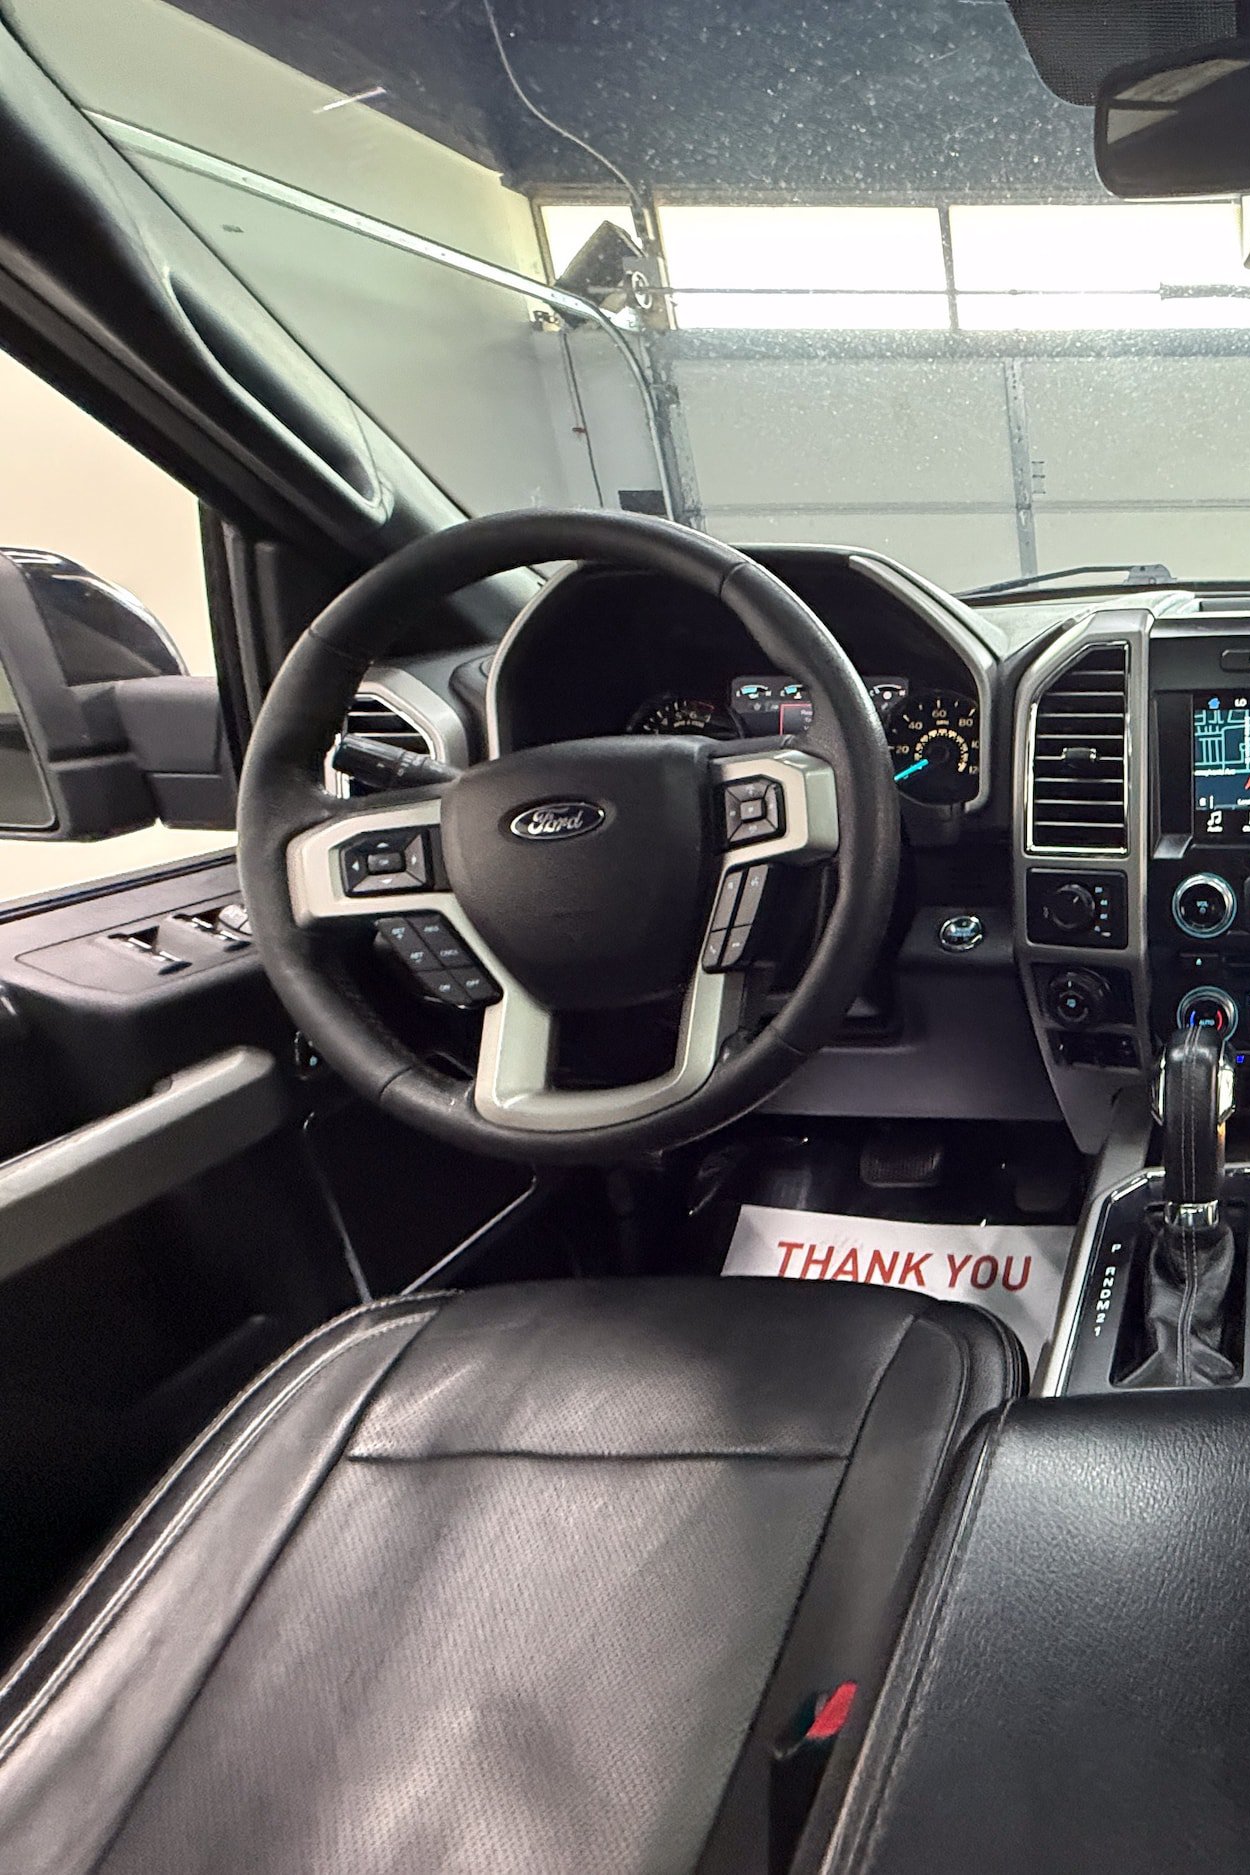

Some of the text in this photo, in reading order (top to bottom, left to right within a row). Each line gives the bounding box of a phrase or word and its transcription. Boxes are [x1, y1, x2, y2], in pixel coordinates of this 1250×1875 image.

[932, 710, 946, 718] 60
[908, 721, 923, 730] 40
[959, 719, 973, 727] 80
[527, 808, 584, 835] Ford
[777, 1241, 1032, 1291] THANK YOU
[1103, 1278, 1114, 1287] N
[1100, 1289, 1111, 1299] D
[1096, 1300, 1110, 1311] M
[1096, 1313, 1105, 1323] 2
